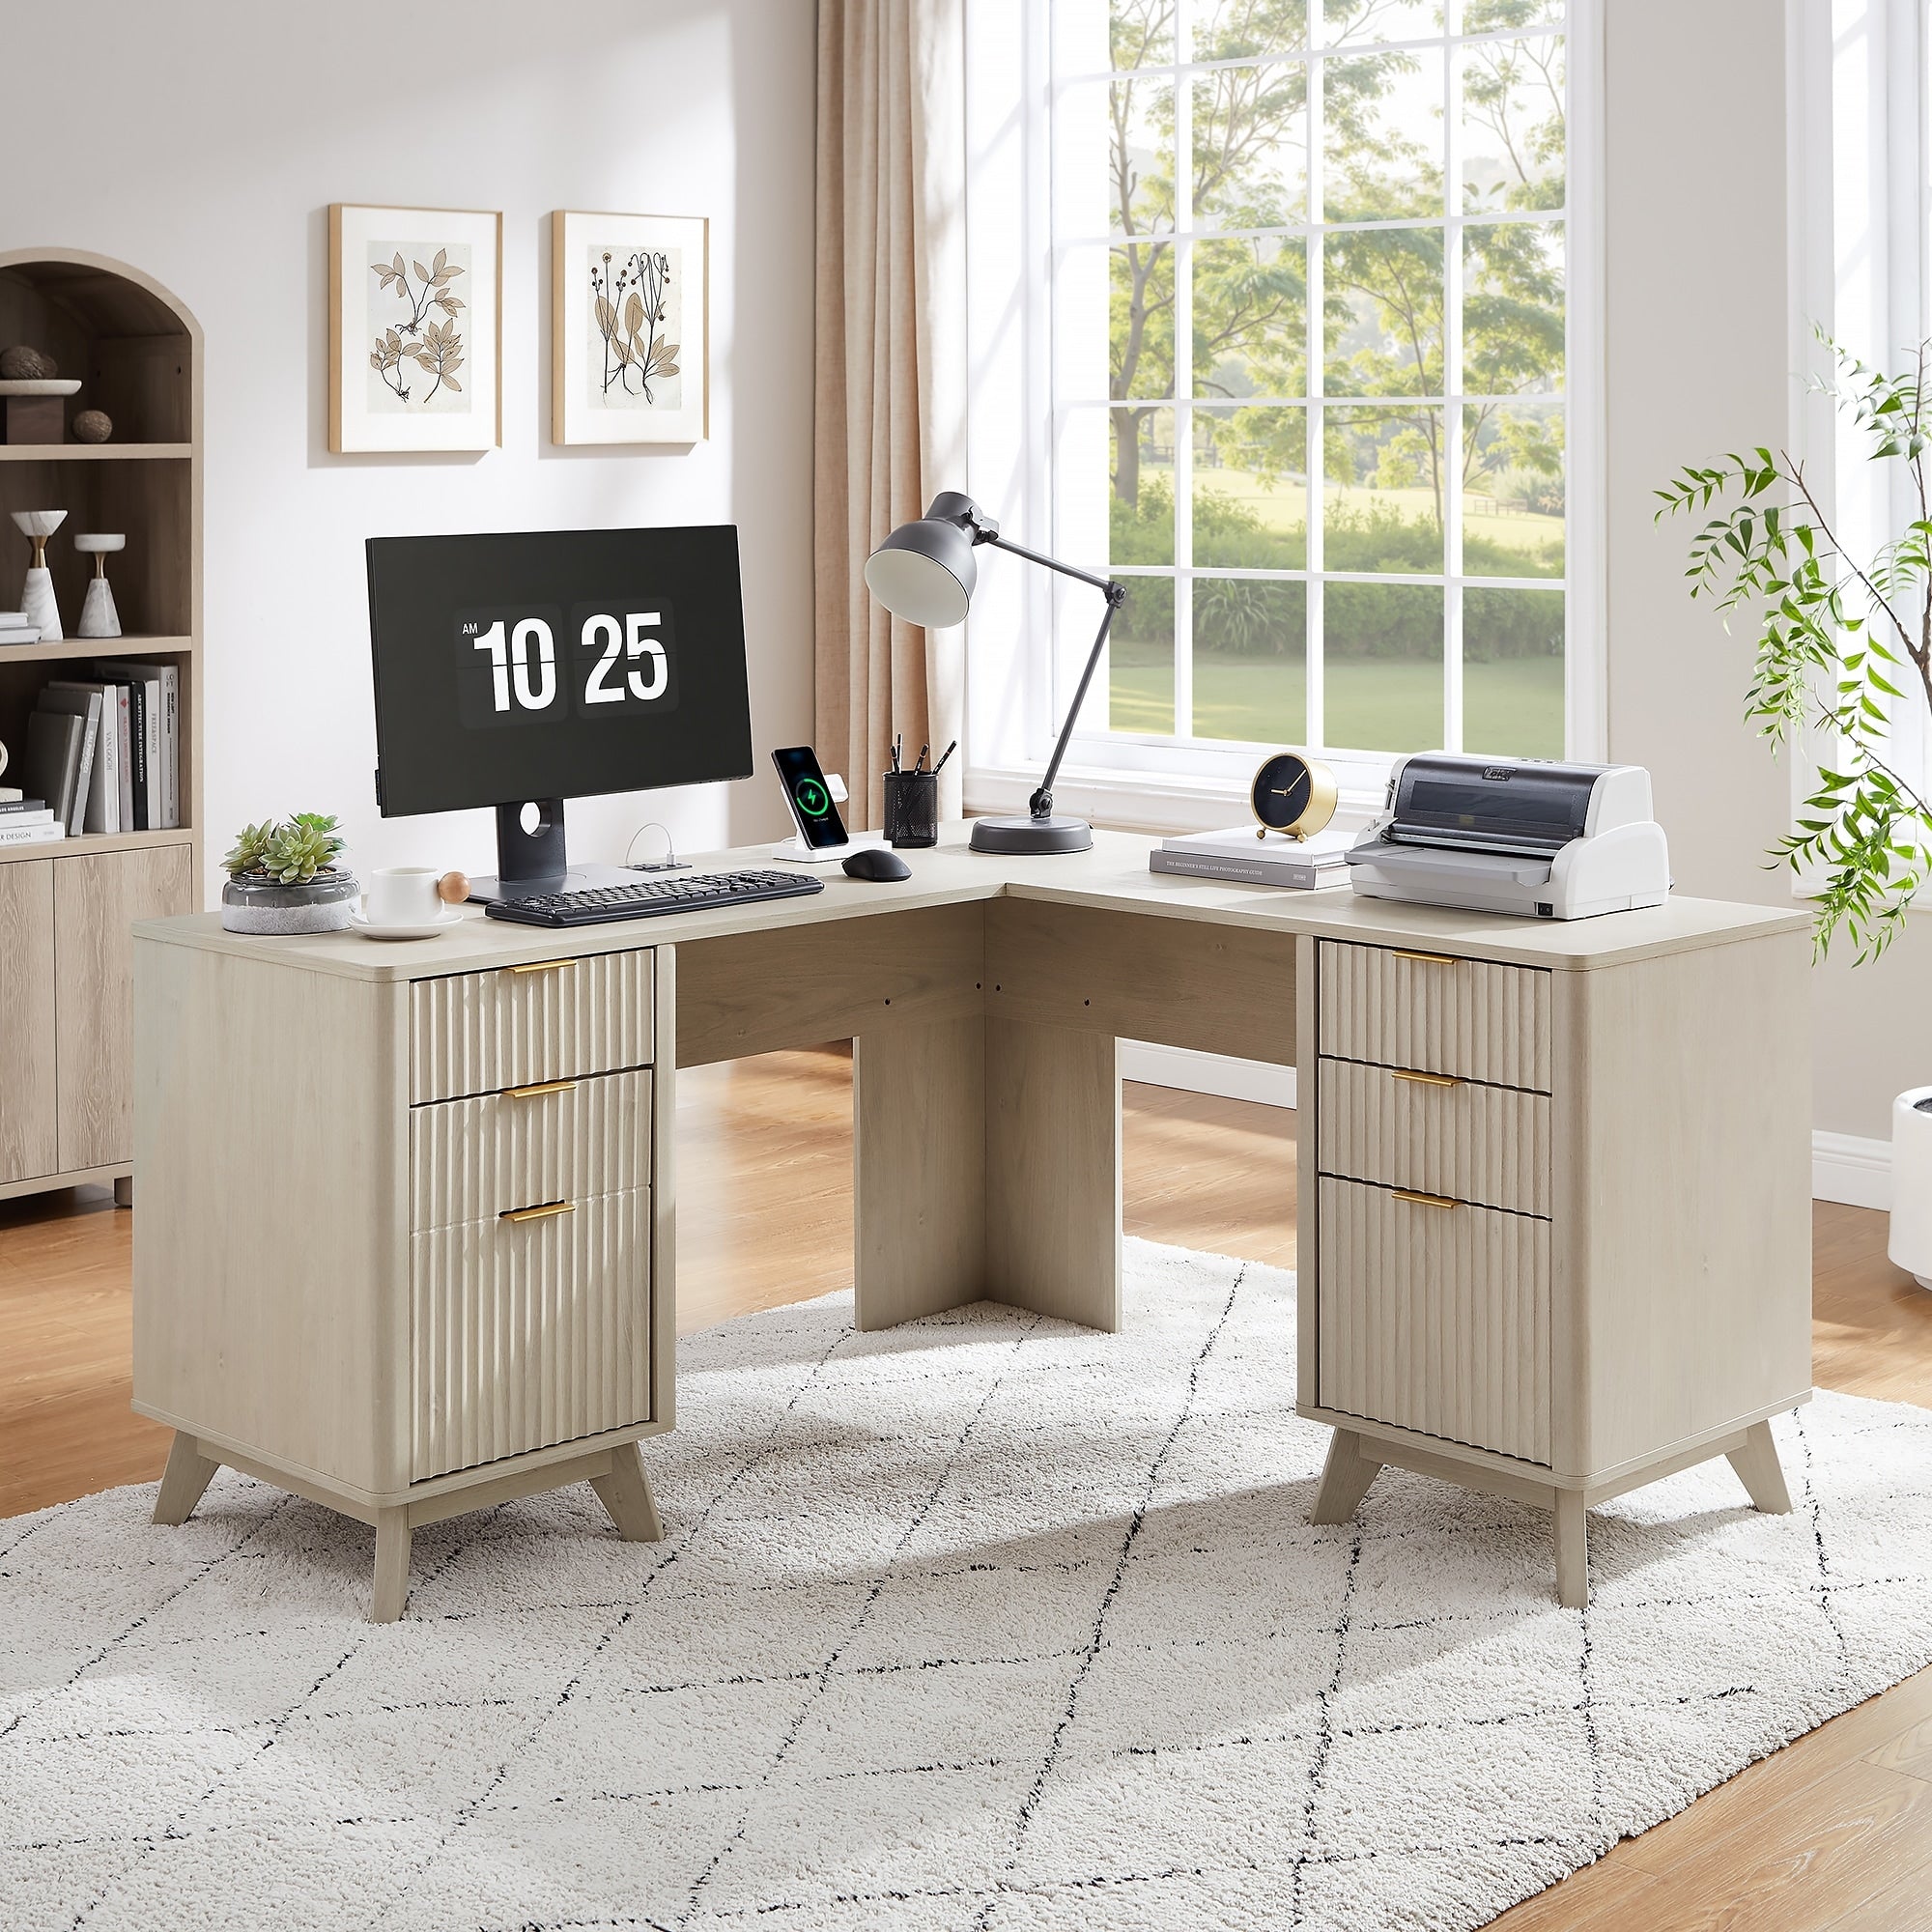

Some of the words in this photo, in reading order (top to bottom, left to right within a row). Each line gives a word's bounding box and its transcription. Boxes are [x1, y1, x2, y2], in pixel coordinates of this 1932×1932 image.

[462, 622, 478, 635] AM
[472, 616, 557, 713] 10
[580, 611, 668, 705] 25
[6, 831, 31, 840] DESIGN
[1219, 866, 1249, 874] PHOTOGRAPHY
